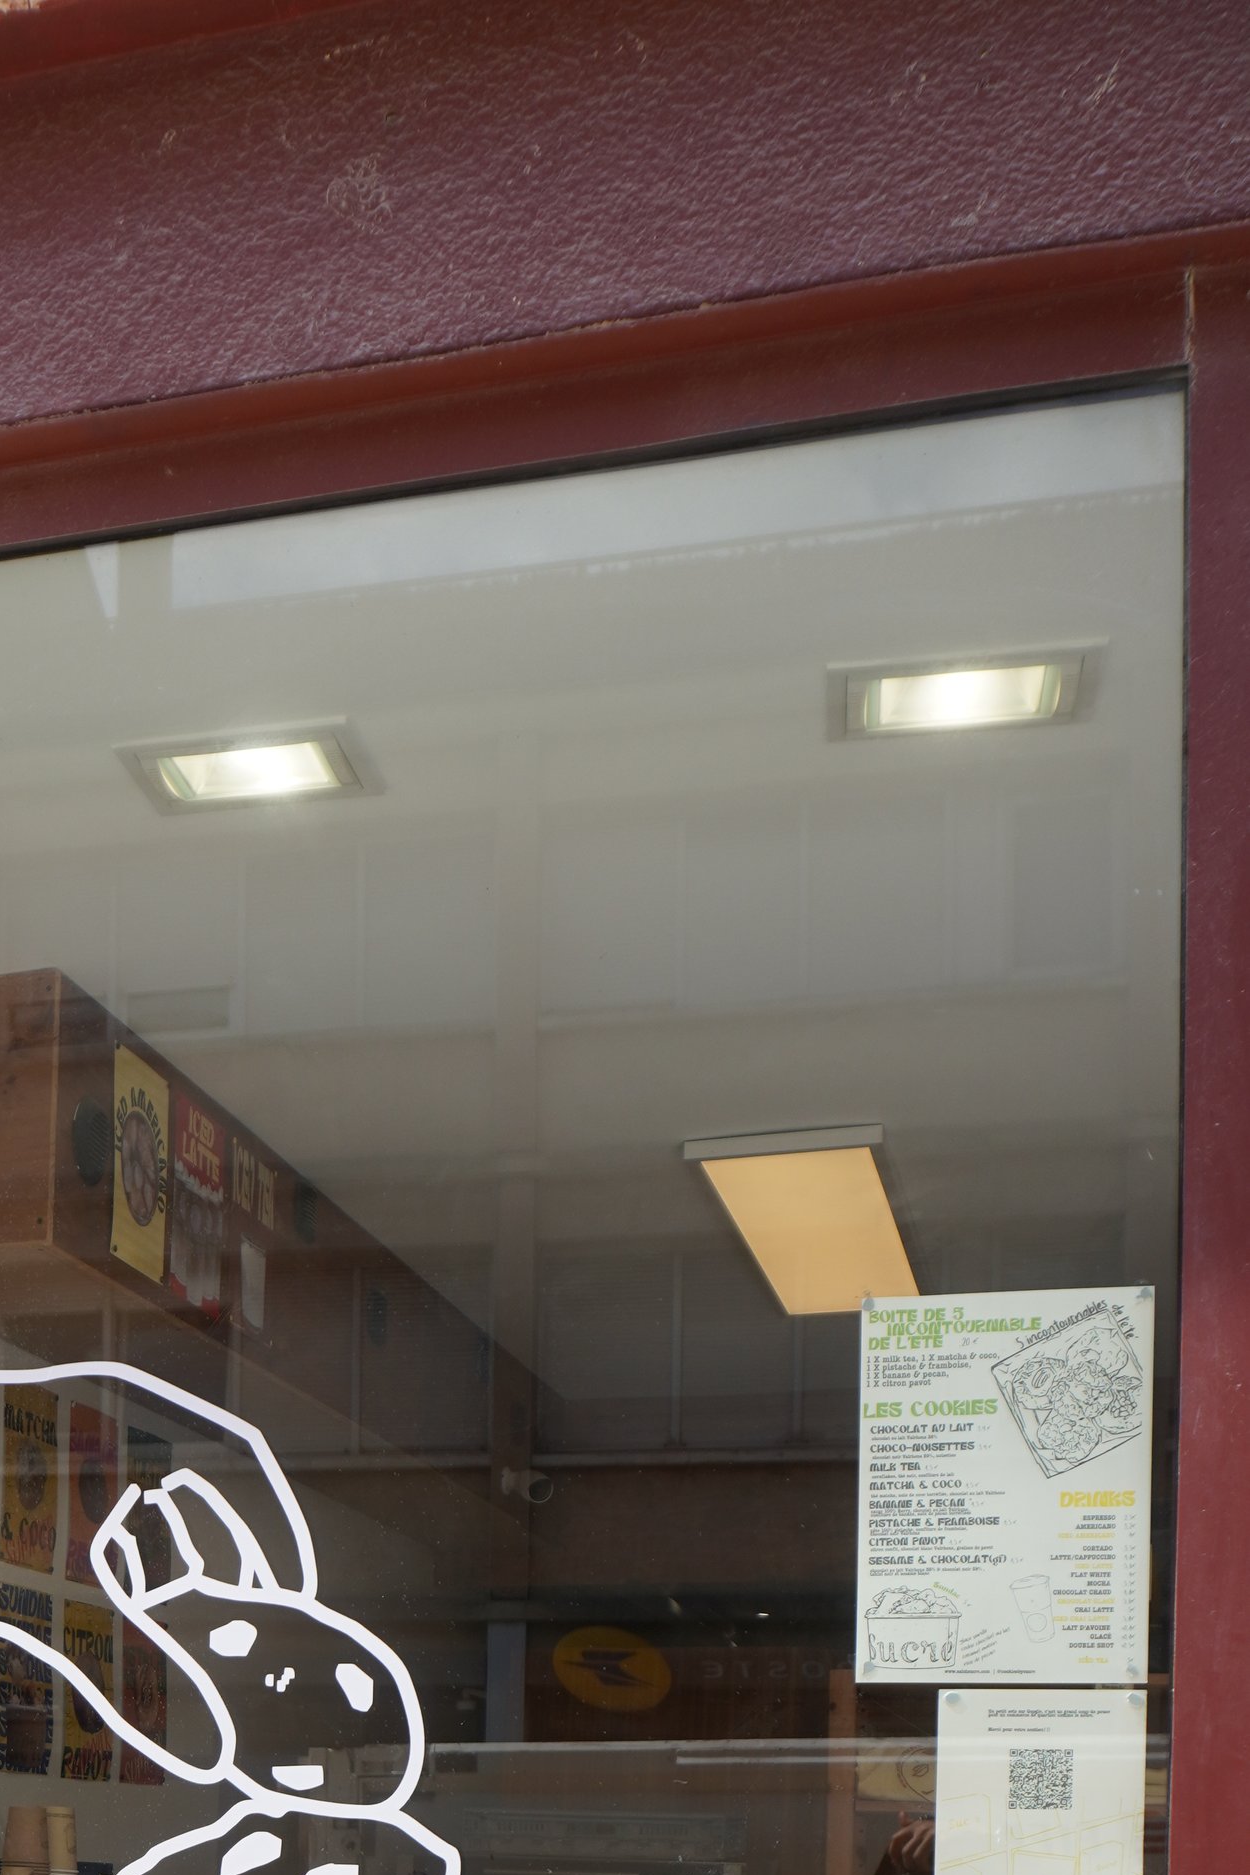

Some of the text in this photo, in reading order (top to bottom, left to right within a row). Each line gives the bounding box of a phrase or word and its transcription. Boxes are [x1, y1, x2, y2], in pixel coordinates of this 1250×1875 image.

[189, 1105, 215, 1147] ICED
[182, 1132, 221, 1186] LATTE
[869, 1307, 964, 1324] BOITE DE 5
[1026, 1300, 1108, 1344] incontournables
[887, 1317, 1042, 1336] INCONTOURNABLE
[868, 1337, 890, 1350] DE
[883, 1355, 900, 1363] milk
[938, 1353, 967, 1361] matcha
[883, 1362, 917, 1373] pistache
[883, 1371, 911, 1380] banane
[882, 1379, 906, 1387] citron
[909, 1379, 931, 1388] pavot
[863, 1399, 998, 1419] LES COOKIES
[4, 1403, 58, 1448] MATCHA
[870, 1424, 928, 1435] CHOCOLAT
[932, 1424, 945, 1433] AU
[949, 1423, 974, 1432] LAIT
[870, 1442, 975, 1453] CHOCO-NOISETTES
[870, 1462, 921, 1472] MILK TEA
[870, 1480, 962, 1491] MATCHA & COCO
[869, 1498, 966, 1509] BANANE & PECAN
[1059, 1490, 1136, 1508] DRINKS
[869, 1517, 1000, 1528] PISTACHE & FRAMBOISE
[1, 1511, 57, 1552] & COCO
[869, 1536, 945, 1546] CITRON PAVOT
[868, 1556, 914, 1565] SESAME
[918, 1555, 926, 1564] &
[0, 1583, 53, 1622] SUNDAE
[63, 1626, 114, 1664] CITRON
[868, 1631, 954, 1664] Sucré
[60, 1746, 113, 1782] PAVOT
